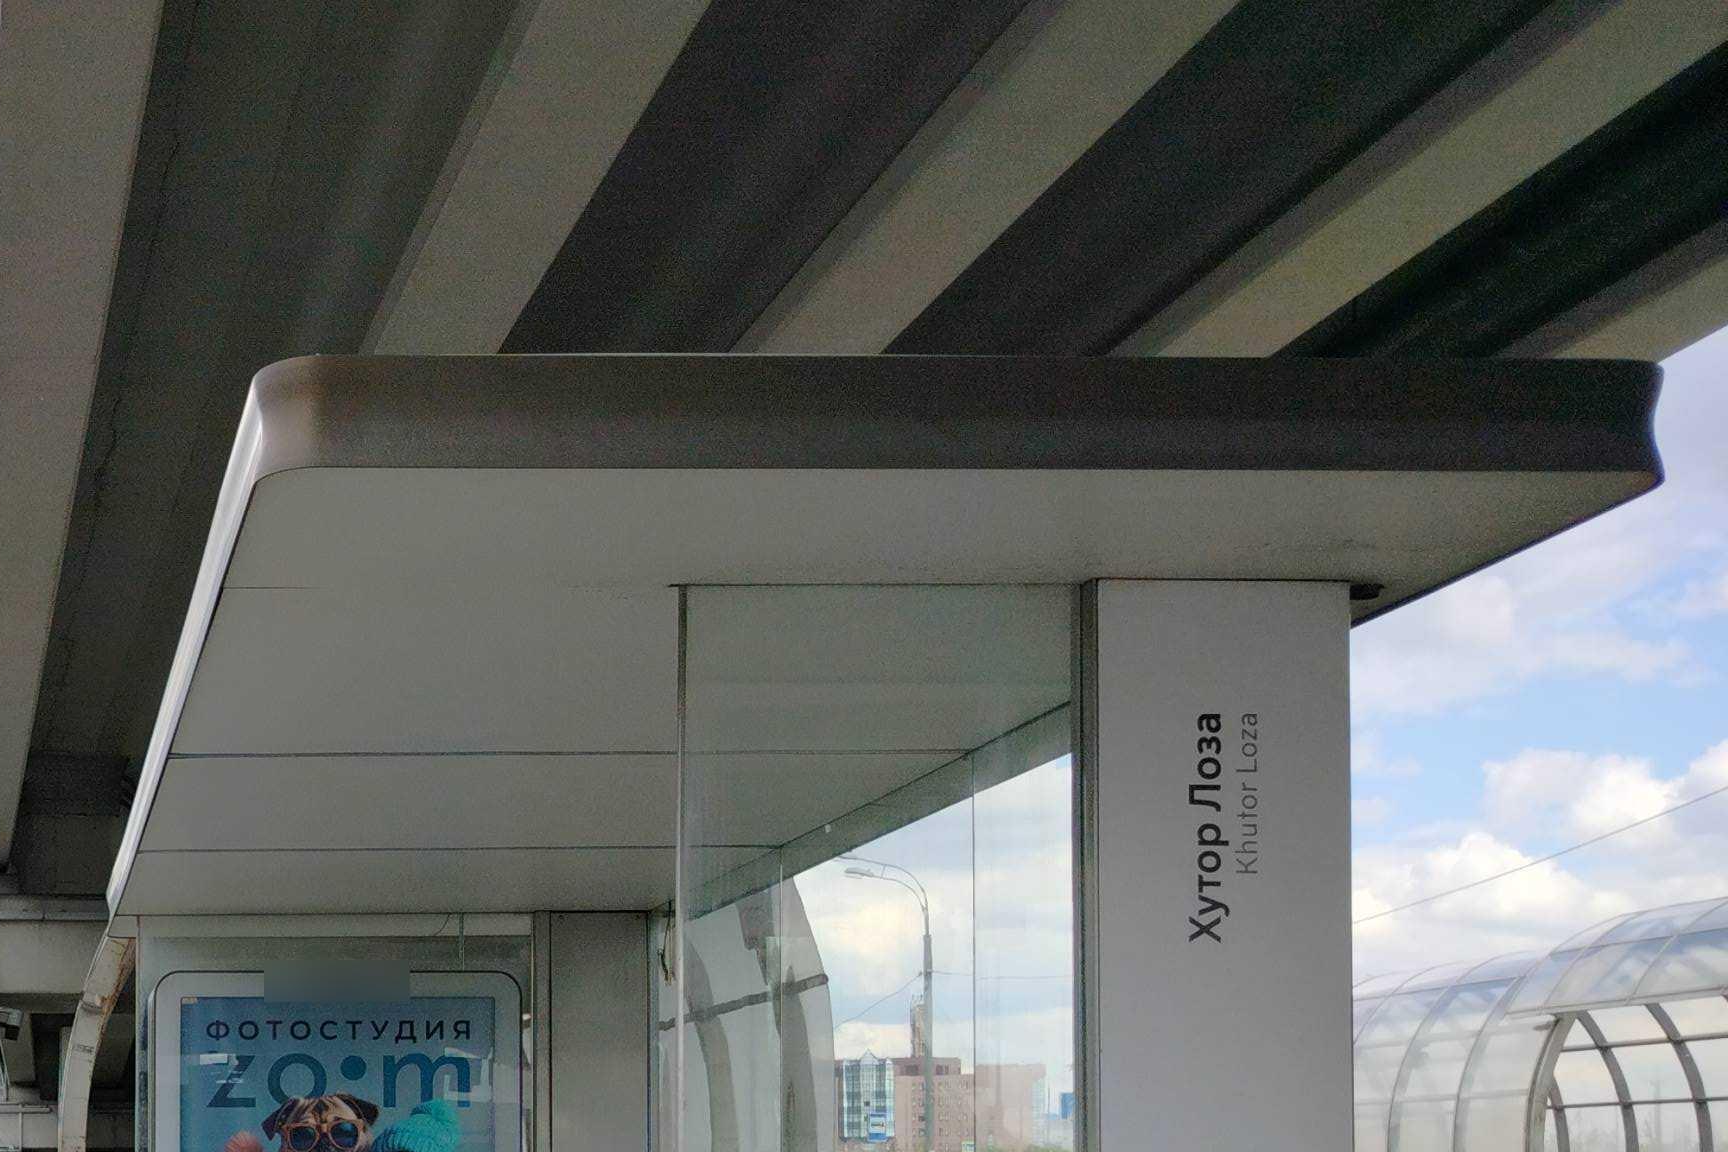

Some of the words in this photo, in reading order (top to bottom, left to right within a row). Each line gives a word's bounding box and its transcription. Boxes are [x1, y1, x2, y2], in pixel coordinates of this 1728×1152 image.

[1188, 713, 1221, 812] Лоза
[1235, 712, 1258, 773] Loza
[1235, 782, 1258, 874] Khutor
[1188, 823, 1230, 943] Хутор
[206, 1020, 471, 1043] ФОТОСТУДИЯ
